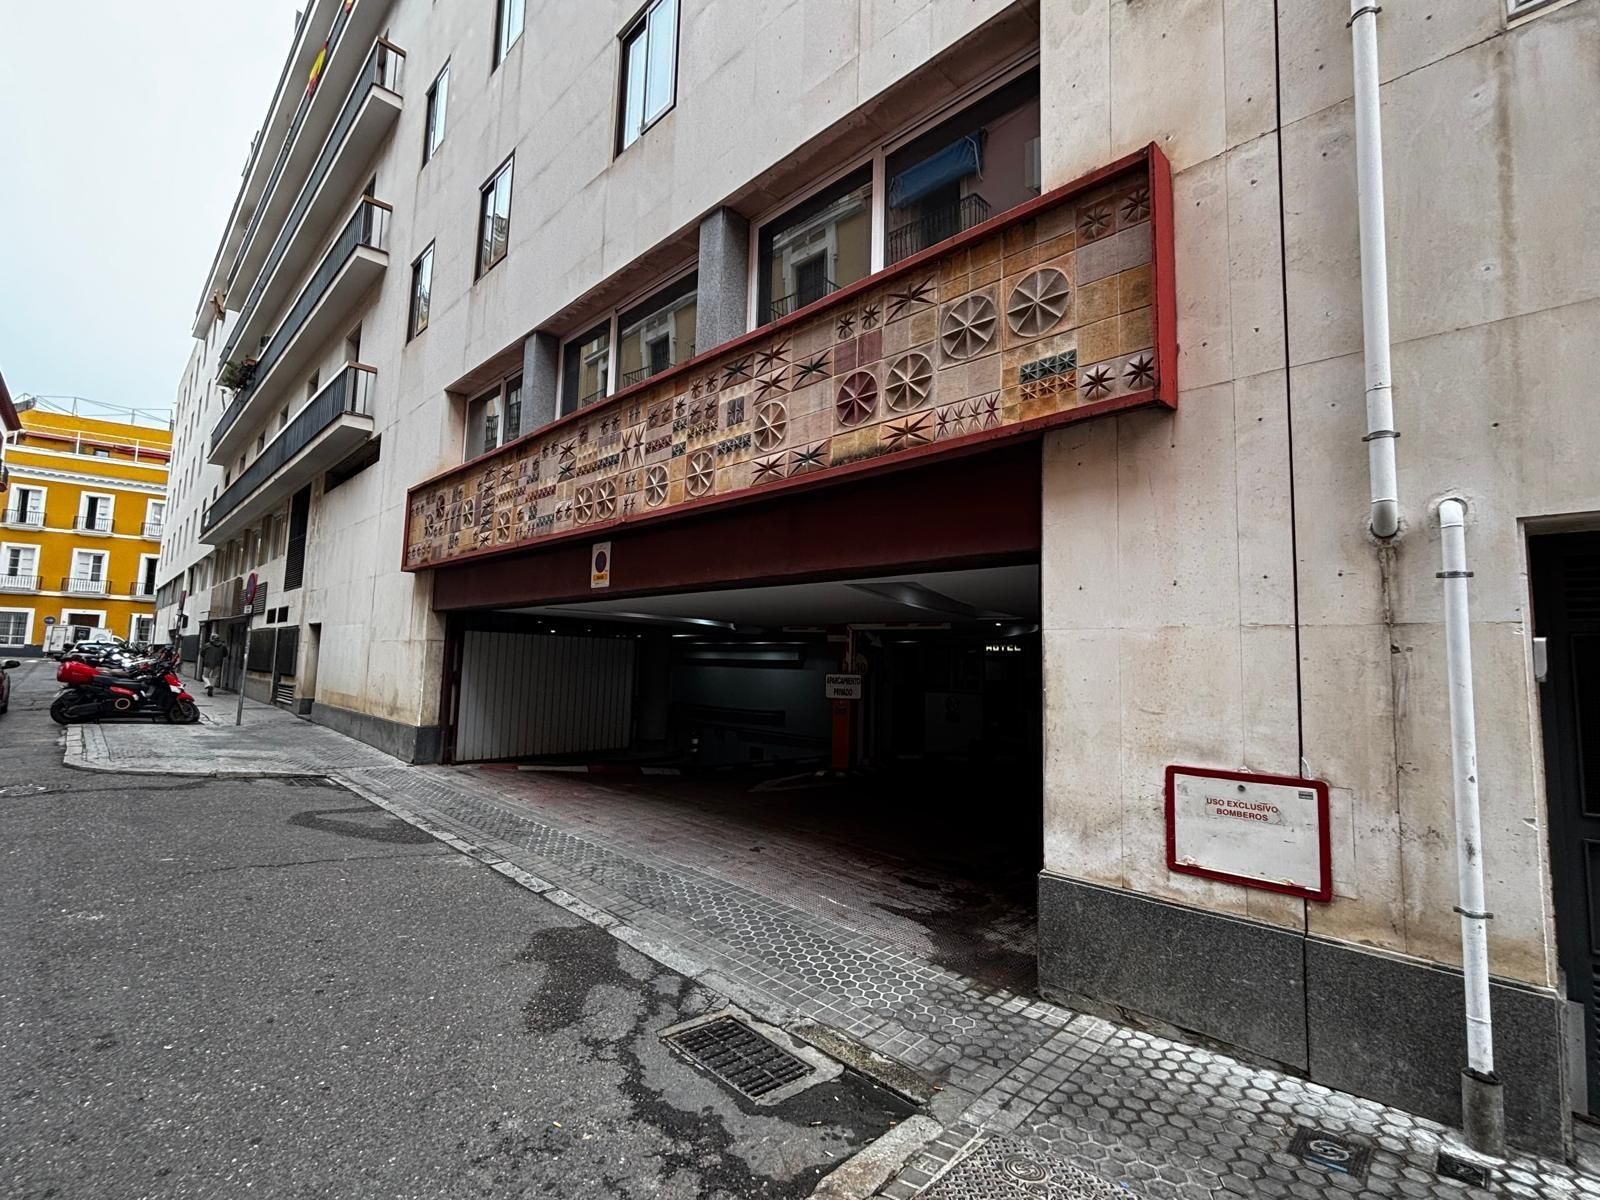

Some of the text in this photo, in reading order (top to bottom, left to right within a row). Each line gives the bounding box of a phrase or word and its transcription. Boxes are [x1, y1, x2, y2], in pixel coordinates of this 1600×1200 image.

[985, 643, 1022, 652] HOTEL
[826, 676, 861, 685] APARCAMIENTO
[833, 687, 853, 697] PRIVADO
[1206, 797, 1278, 814] USO EXCLUSIVO
[1216, 808, 1269, 822] BOMBEROS
